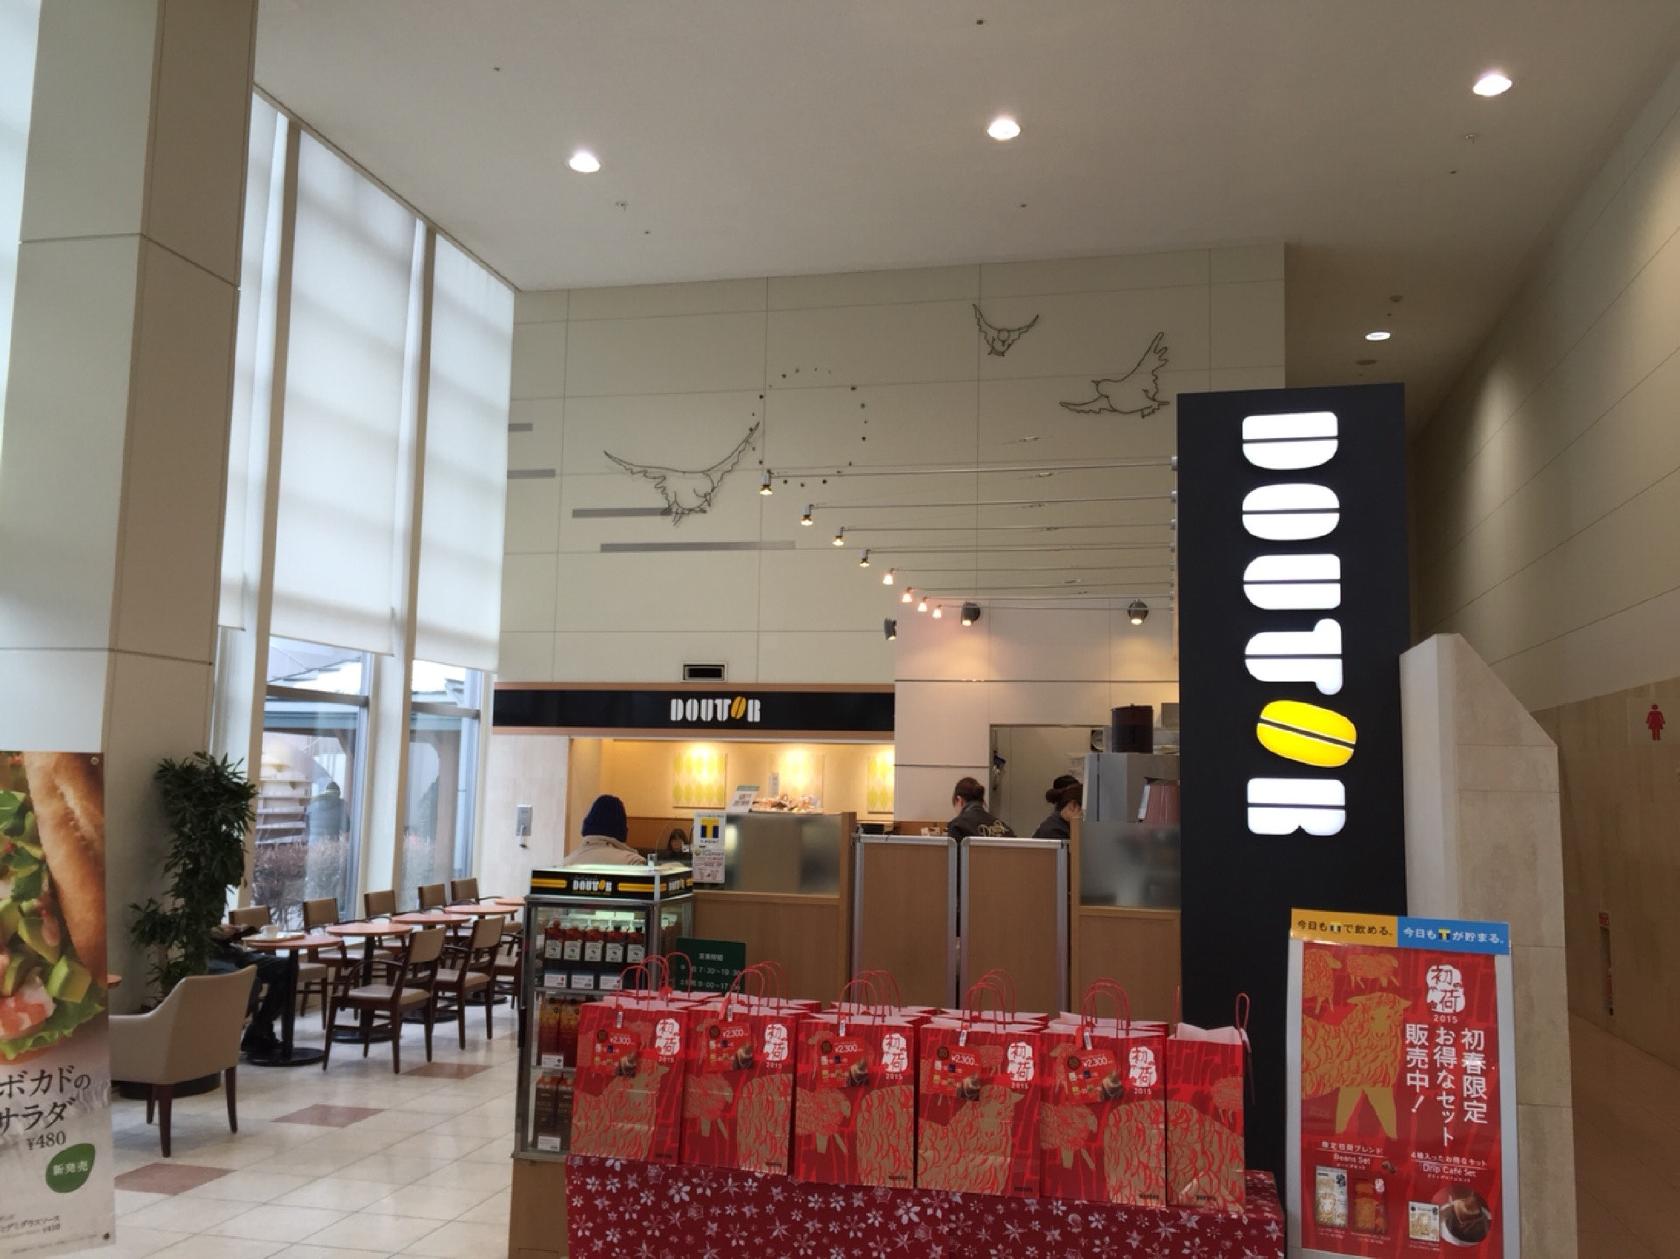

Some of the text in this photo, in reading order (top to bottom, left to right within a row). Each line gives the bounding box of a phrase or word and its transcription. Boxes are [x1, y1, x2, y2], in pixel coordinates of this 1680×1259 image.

[1242, 411, 1357, 836] DOUTOR
[670, 696, 761, 722] DOUTOR
[572, 879, 613, 892] DOUTOR
[1433, 1014, 1458, 1024] 2015
[1433, 1026, 1458, 1147] お得なセット
[1461, 1028, 1488, 1124] 初春限定
[26, 1130, 67, 1151] ¥480
